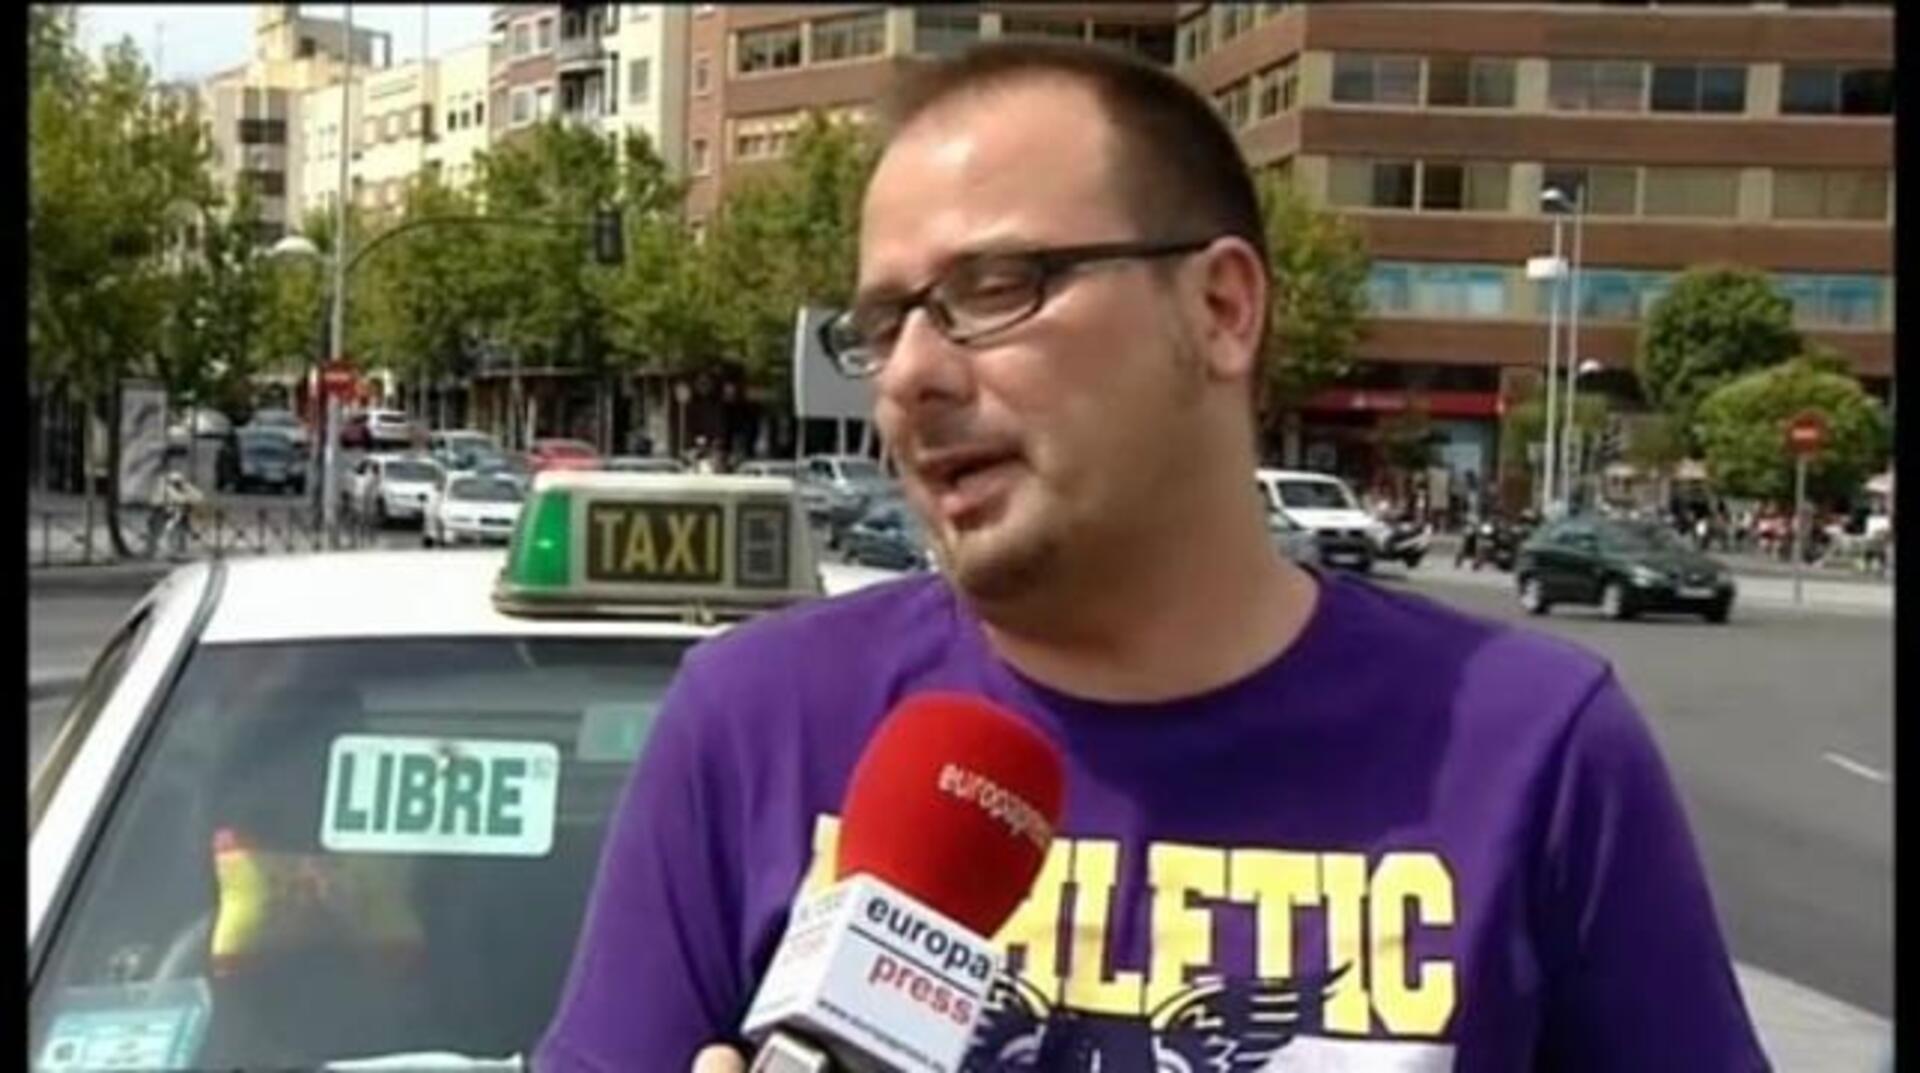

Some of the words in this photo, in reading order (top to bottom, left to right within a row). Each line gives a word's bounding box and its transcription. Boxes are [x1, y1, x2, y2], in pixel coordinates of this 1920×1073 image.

[593, 509, 718, 575] TAXI
[332, 752, 526, 837] LIBRE
[865, 896, 991, 981] europa
[868, 953, 973, 1026] press
